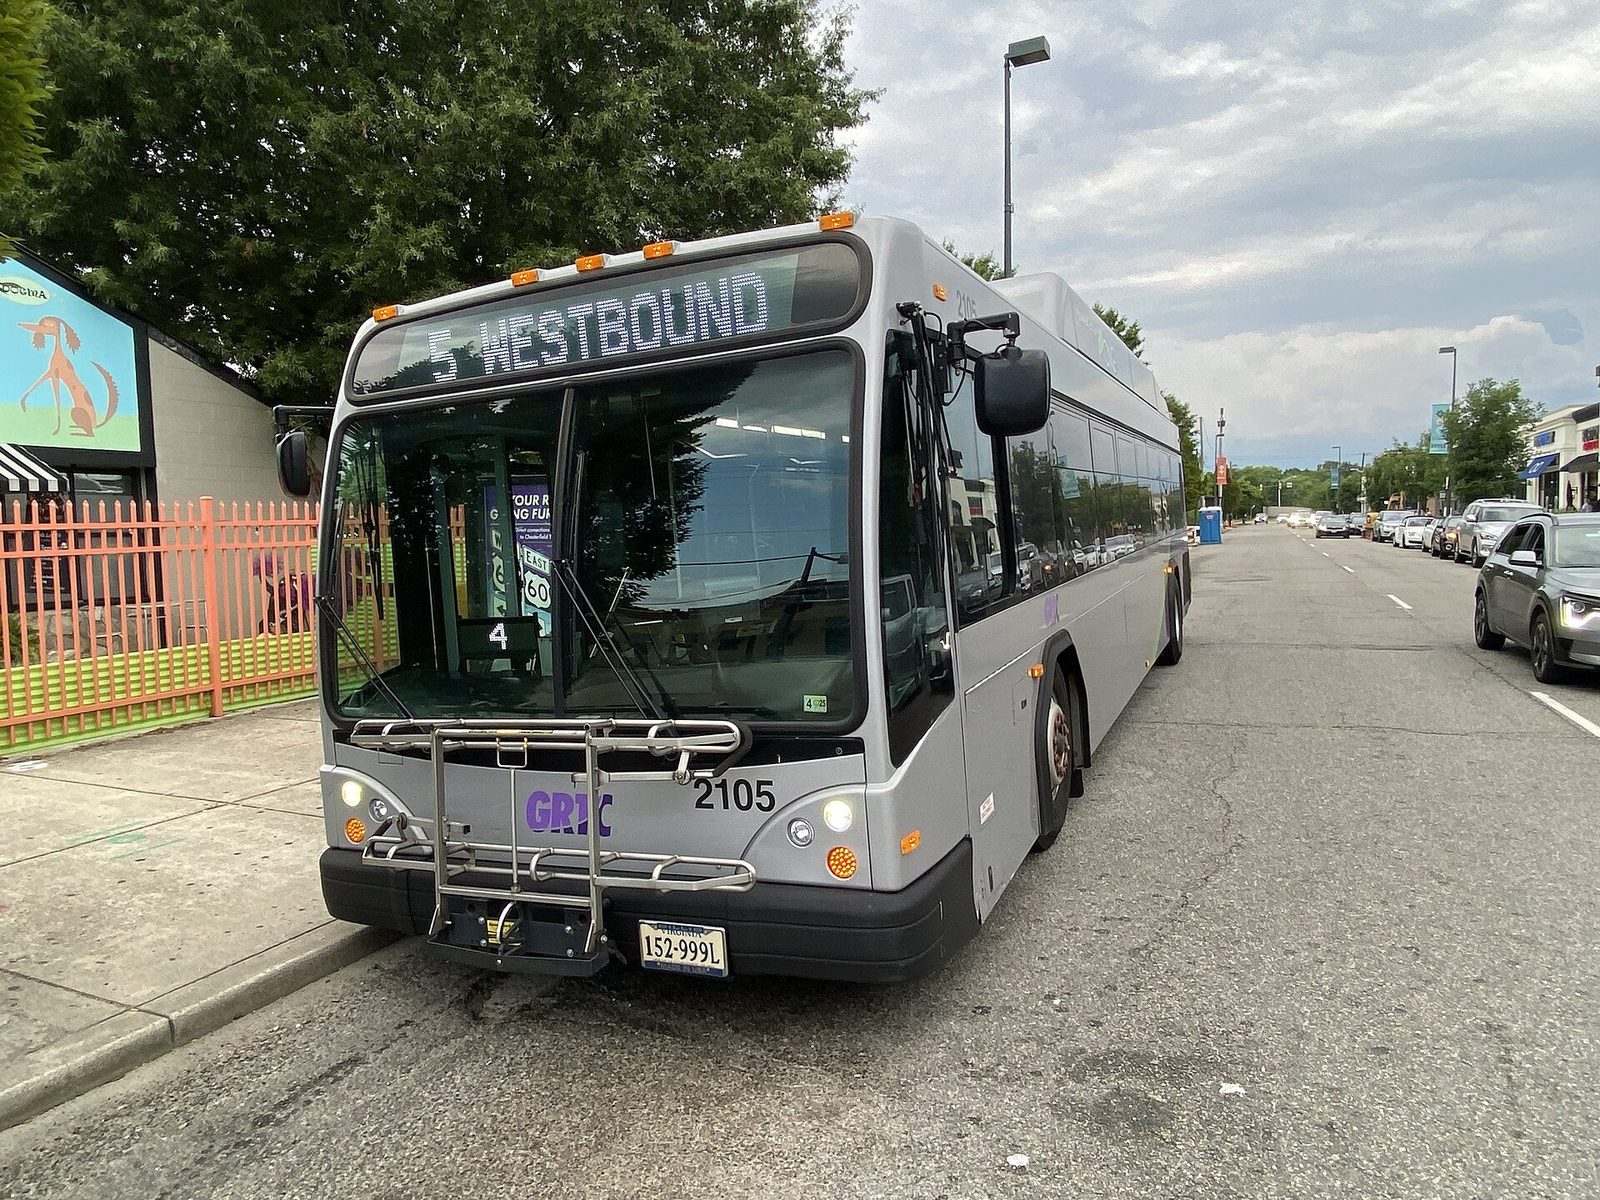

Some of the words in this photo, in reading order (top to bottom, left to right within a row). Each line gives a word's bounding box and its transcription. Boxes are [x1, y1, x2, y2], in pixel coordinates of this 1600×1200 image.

[427, 327, 458, 383] 5
[479, 271, 769, 376] WESTBOUND
[525, 550, 547, 570] EAST
[527, 579, 549, 602] 60
[488, 622, 508, 651] 4
[694, 778, 776, 813] 2105
[645, 935, 720, 965] 152-999L
